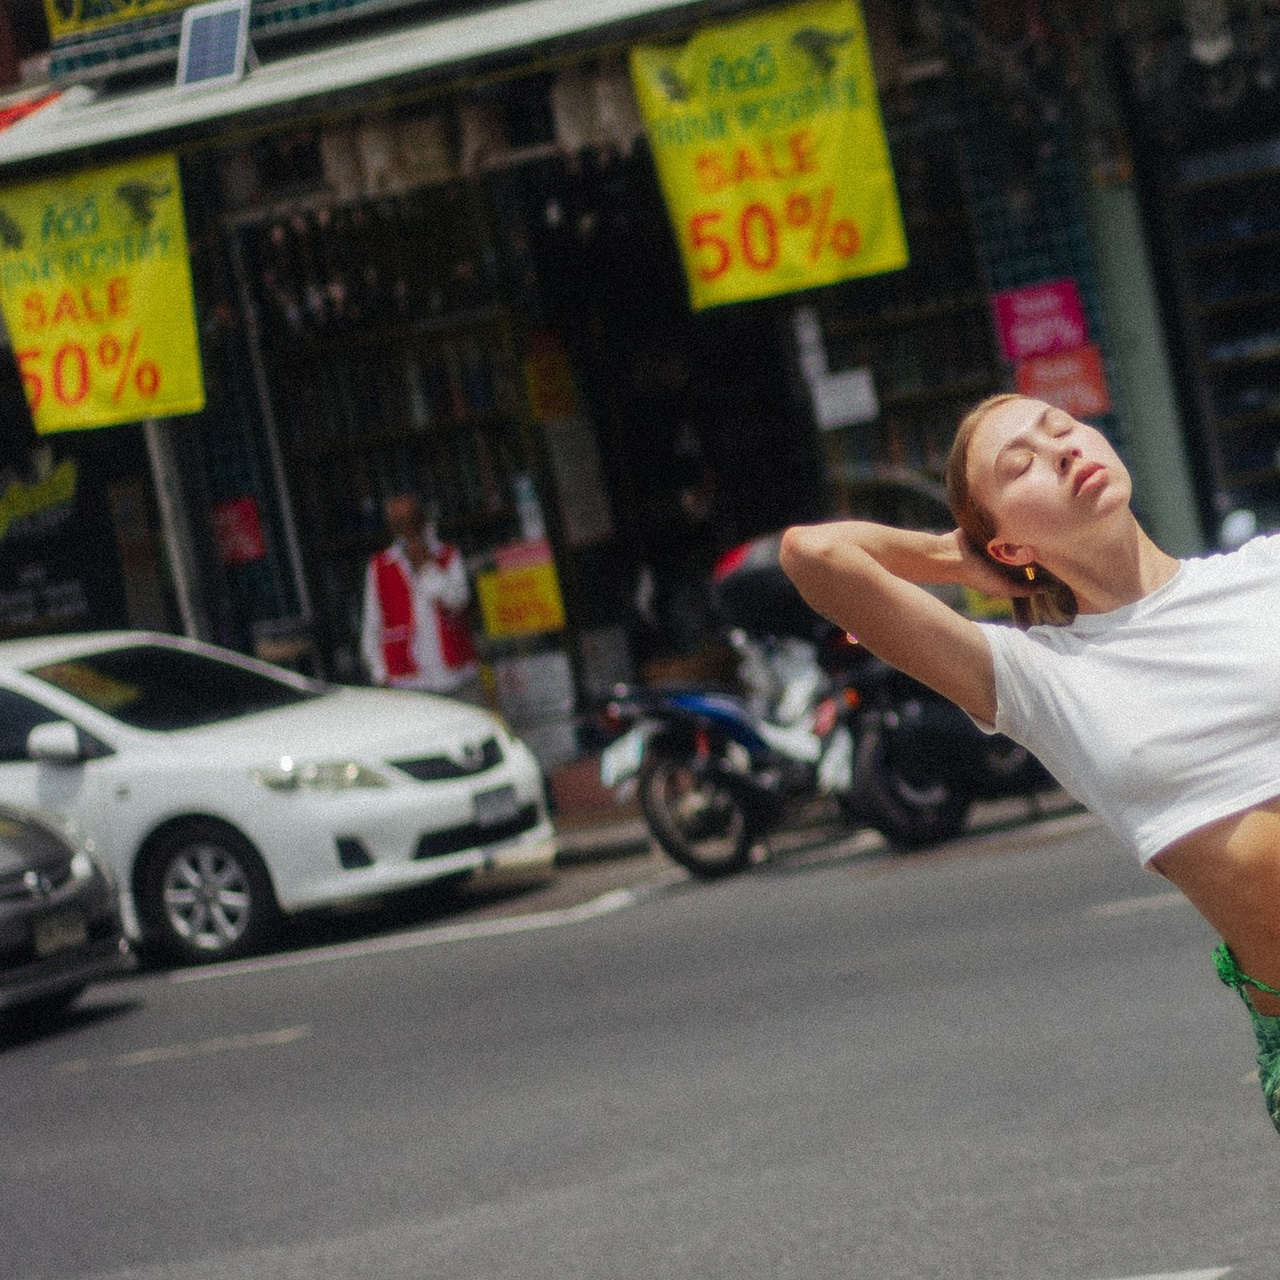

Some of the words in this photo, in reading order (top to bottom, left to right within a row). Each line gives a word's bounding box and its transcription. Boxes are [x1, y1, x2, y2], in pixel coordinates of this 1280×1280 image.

[694, 128, 820, 195] SALE
[687, 183, 862, 284] 50%
[21, 273, 132, 334] SALE
[16, 326, 162, 417] 50%
